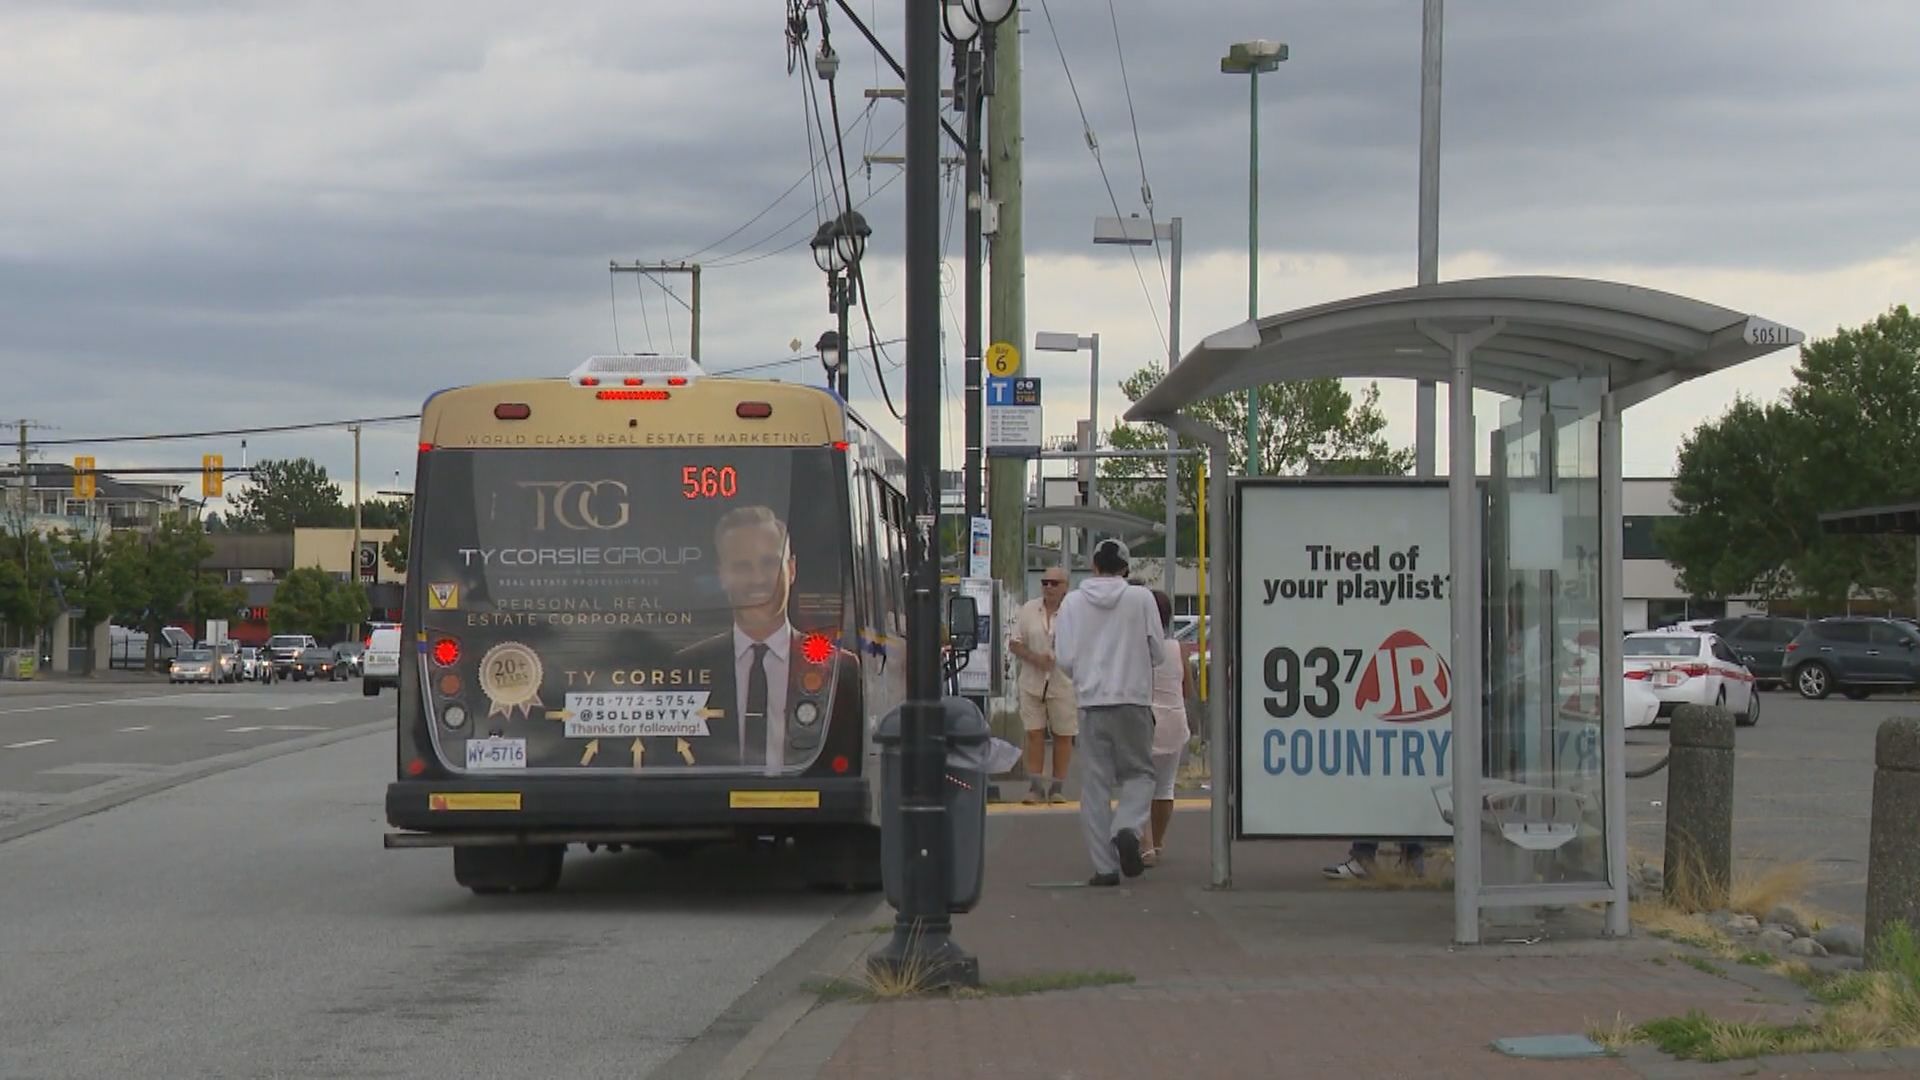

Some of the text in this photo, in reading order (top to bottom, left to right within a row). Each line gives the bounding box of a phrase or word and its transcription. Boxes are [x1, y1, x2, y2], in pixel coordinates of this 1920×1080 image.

[1752, 327, 1789, 344] 50511
[996, 355, 1007, 371] 6
[991, 382, 1007, 402] T
[465, 432, 811, 445] WORLD CLASS REAL ESTATE MARKETING
[681, 466, 738, 498] 560
[459, 548, 496, 566] TY
[1305, 545, 1420, 572] Tired of
[1262, 578, 1329, 606] your
[497, 597, 663, 611] PERSONAL REAL
[466, 610, 693, 626] ESTATE CORPORATION
[495, 658, 527, 677] 20+
[564, 668, 713, 686] TY CORSIE
[1361, 647, 1449, 714] JR
[574, 694, 697, 707] 778-772-5754
[580, 708, 691, 722] @SOLDBYTY
[571, 720, 702, 736] Thanks for following!
[1263, 728, 1453, 777] COUNTRY
